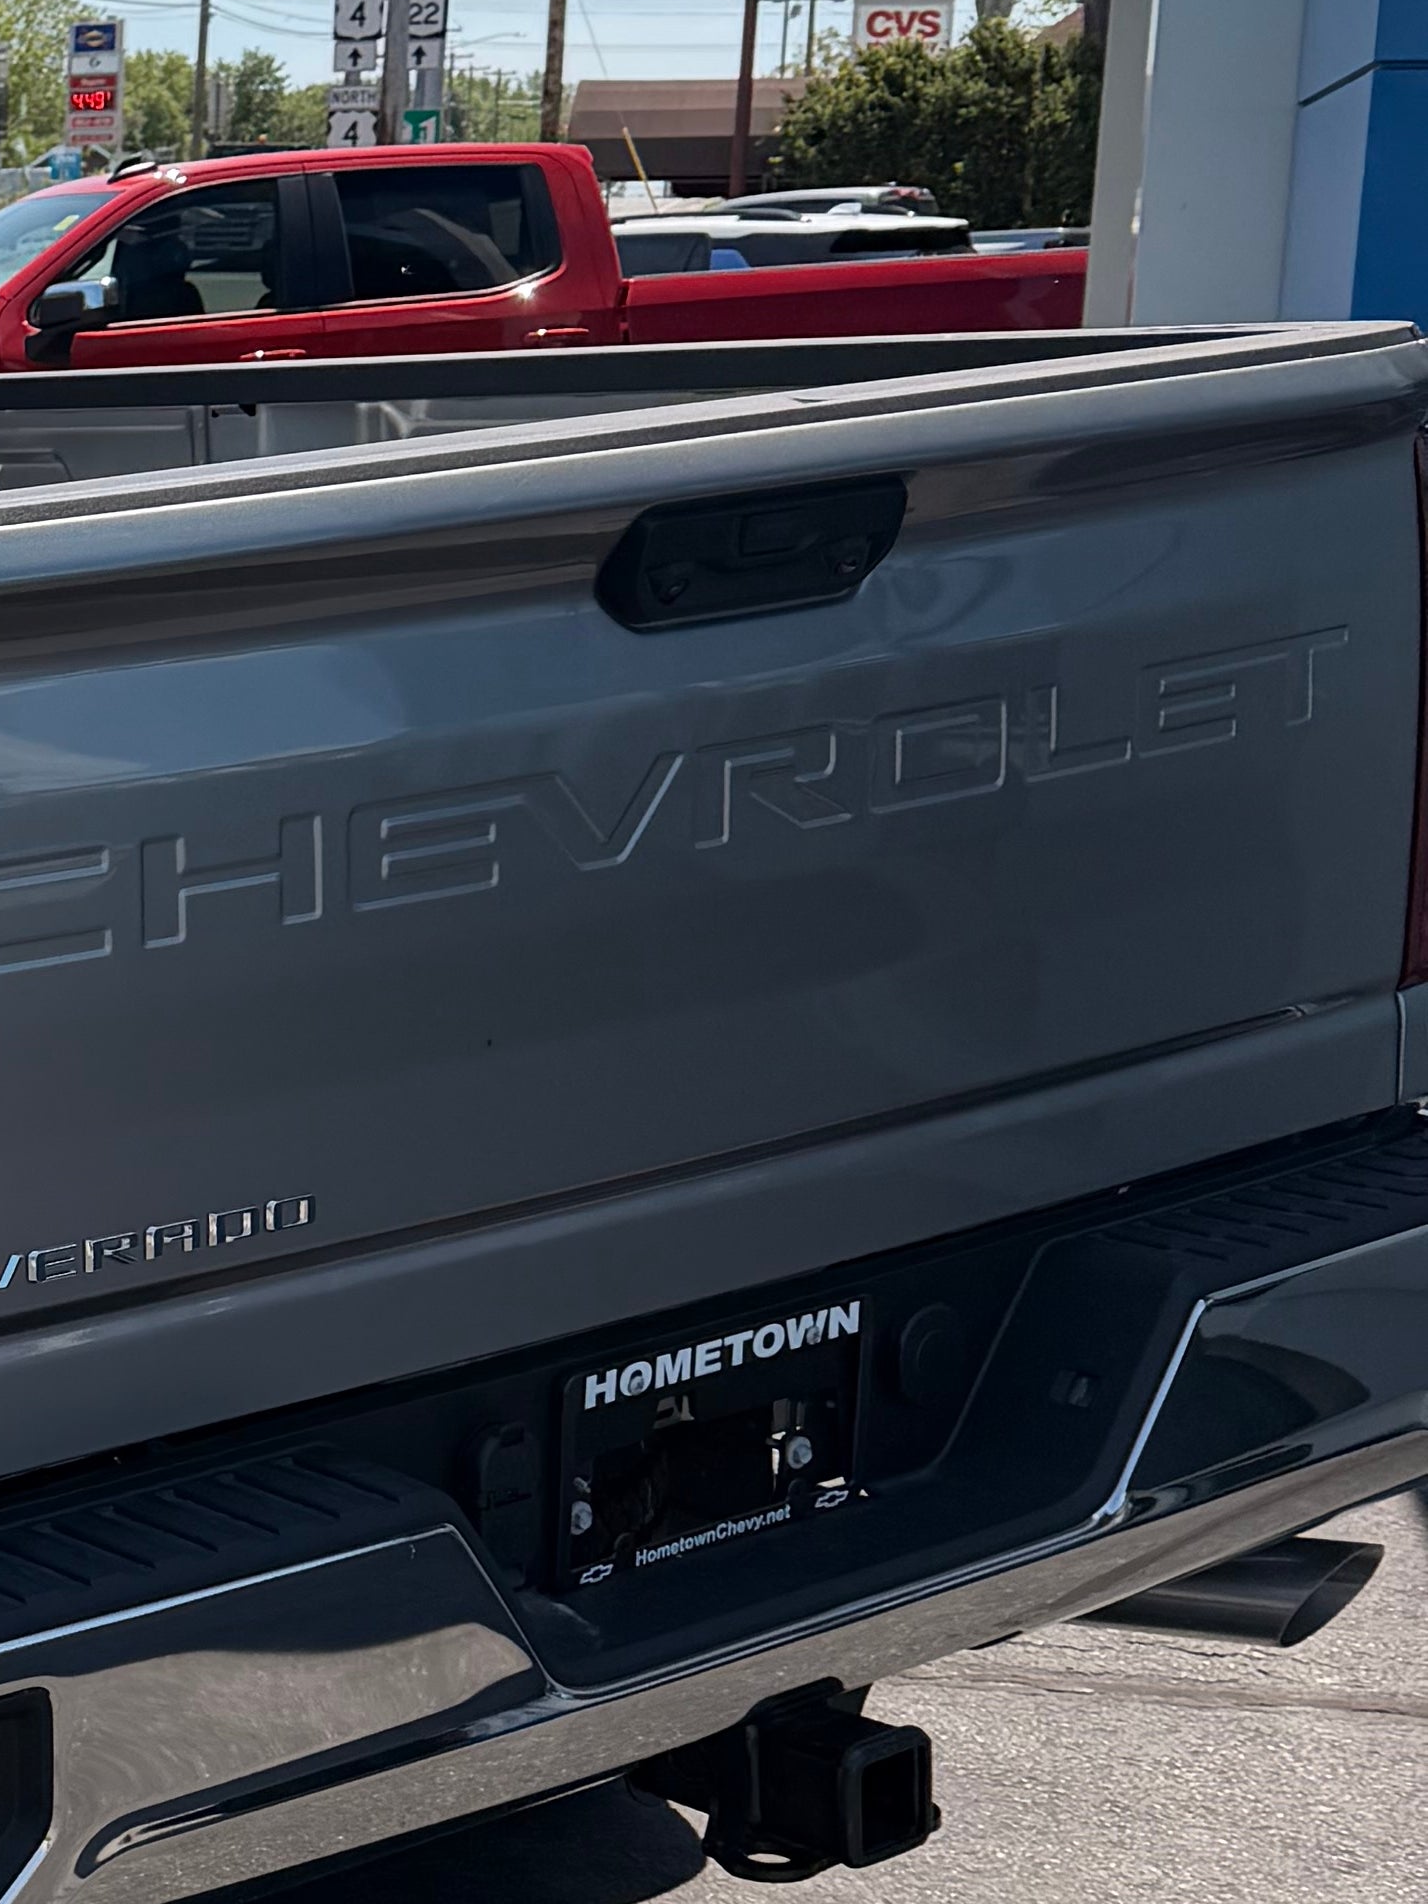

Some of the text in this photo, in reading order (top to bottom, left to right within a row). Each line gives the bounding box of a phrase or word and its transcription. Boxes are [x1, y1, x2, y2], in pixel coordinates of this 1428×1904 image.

[349, 0, 366, 28] 4
[408, 2, 440, 25] 22
[866, 10, 941, 38] CVS
[332, 90, 376, 104] NORTH
[343, 120, 358, 146] 4
[584, 1300, 860, 1410] HOMETOWN
[635, 1505, 791, 1567] HometownChevy.net
